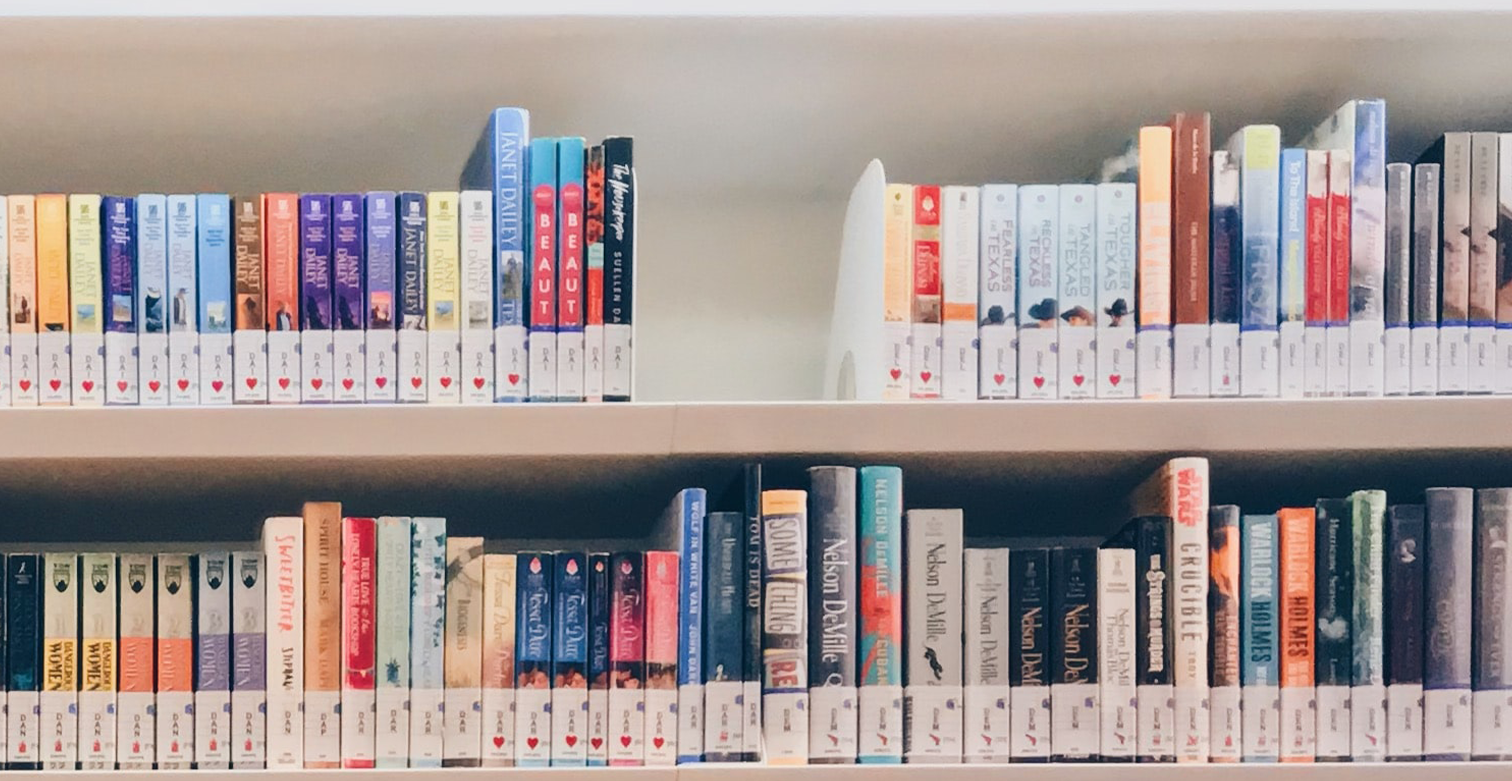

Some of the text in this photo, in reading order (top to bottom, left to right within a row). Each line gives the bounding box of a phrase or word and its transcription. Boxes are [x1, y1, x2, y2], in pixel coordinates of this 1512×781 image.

[502, 131, 518, 245] JANET DAILEY
[612, 164, 628, 180] The
[1290, 160, 1300, 174] To
[75, 252, 86, 296] DAILEY
[236, 245, 248, 284] DAILEY
[249, 252, 260, 290] JANET
[306, 248, 317, 284] DAILEY
[317, 255, 328, 290] JANET
[336, 248, 348, 284] DAILEY
[348, 255, 359, 288] JANET
[404, 228, 417, 313] JANET DAILEY
[432, 250, 444, 292] DAILEY
[467, 249, 478, 292] DAILEY
[478, 258, 488, 294] JANET
[613, 252, 622, 302] SUELLEN
[988, 235, 1000, 292] TEXAS
[1002, 220, 1012, 292] FEARLESS
[1028, 236, 1040, 288] TEXAS
[1041, 220, 1052, 288] RECKLESS
[1064, 236, 1078, 297] TEXAS
[1080, 223, 1090, 297] TANGLED
[1104, 231, 1118, 291] TEXAS
[1120, 212, 1131, 290] TOUGHER
[86, 261, 96, 298] JANET
[318, 518, 329, 604] SPIRIT HOUSE
[689, 502, 699, 614] WOLF IN WHITE VAN
[748, 516, 760, 608] TOM IS DEAD
[876, 479, 888, 598] NELSON DeMILLE
[274, 535, 295, 634] SWEETBITTER
[361, 558, 370, 604] TRUE LOVE
[769, 520, 798, 632] SOME THING
[822, 538, 848, 662] Nelson DeMille
[926, 544, 946, 642] Nelson DeMille
[1180, 543, 1202, 642] CRUCIBLE
[1250, 522, 1272, 662] WARLOCK HOLMES
[1288, 518, 1308, 658] WARLOCK HOLMES
[528, 588, 548, 658] Tessa Dare
[565, 590, 584, 658] Tessa Dare
[688, 624, 698, 654] JOHN
[980, 596, 998, 685] Nelson DeMille
[1021, 607, 1042, 649] Nelson
[1064, 604, 1088, 653] Nelson
[1118, 608, 1128, 647] Nelson
[48, 643, 62, 690] WOMEN
[86, 643, 101, 691] WOMEN
[876, 639, 889, 685] CUBAN
